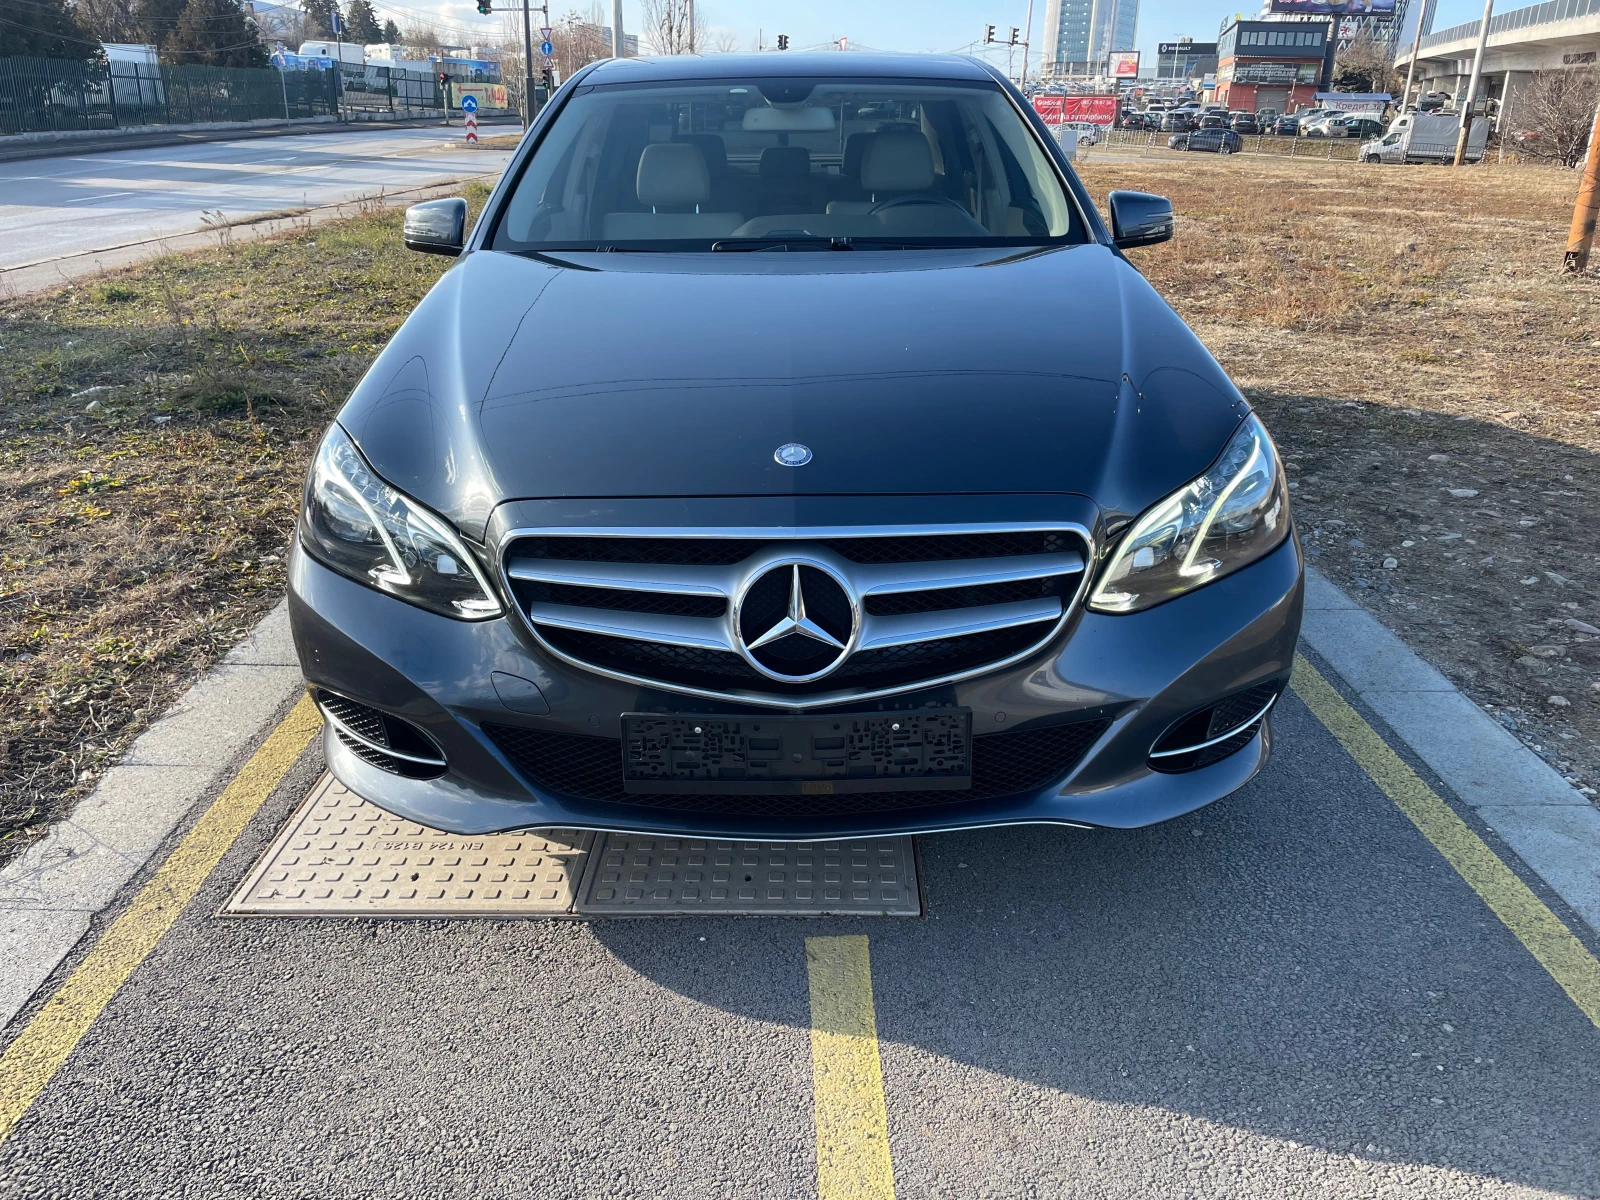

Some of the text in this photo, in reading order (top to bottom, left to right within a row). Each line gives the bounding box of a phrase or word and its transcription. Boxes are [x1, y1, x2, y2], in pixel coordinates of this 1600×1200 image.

[1335, 101, 1369, 110] Кредит
[383, 842, 484, 850] EN 124 B125
